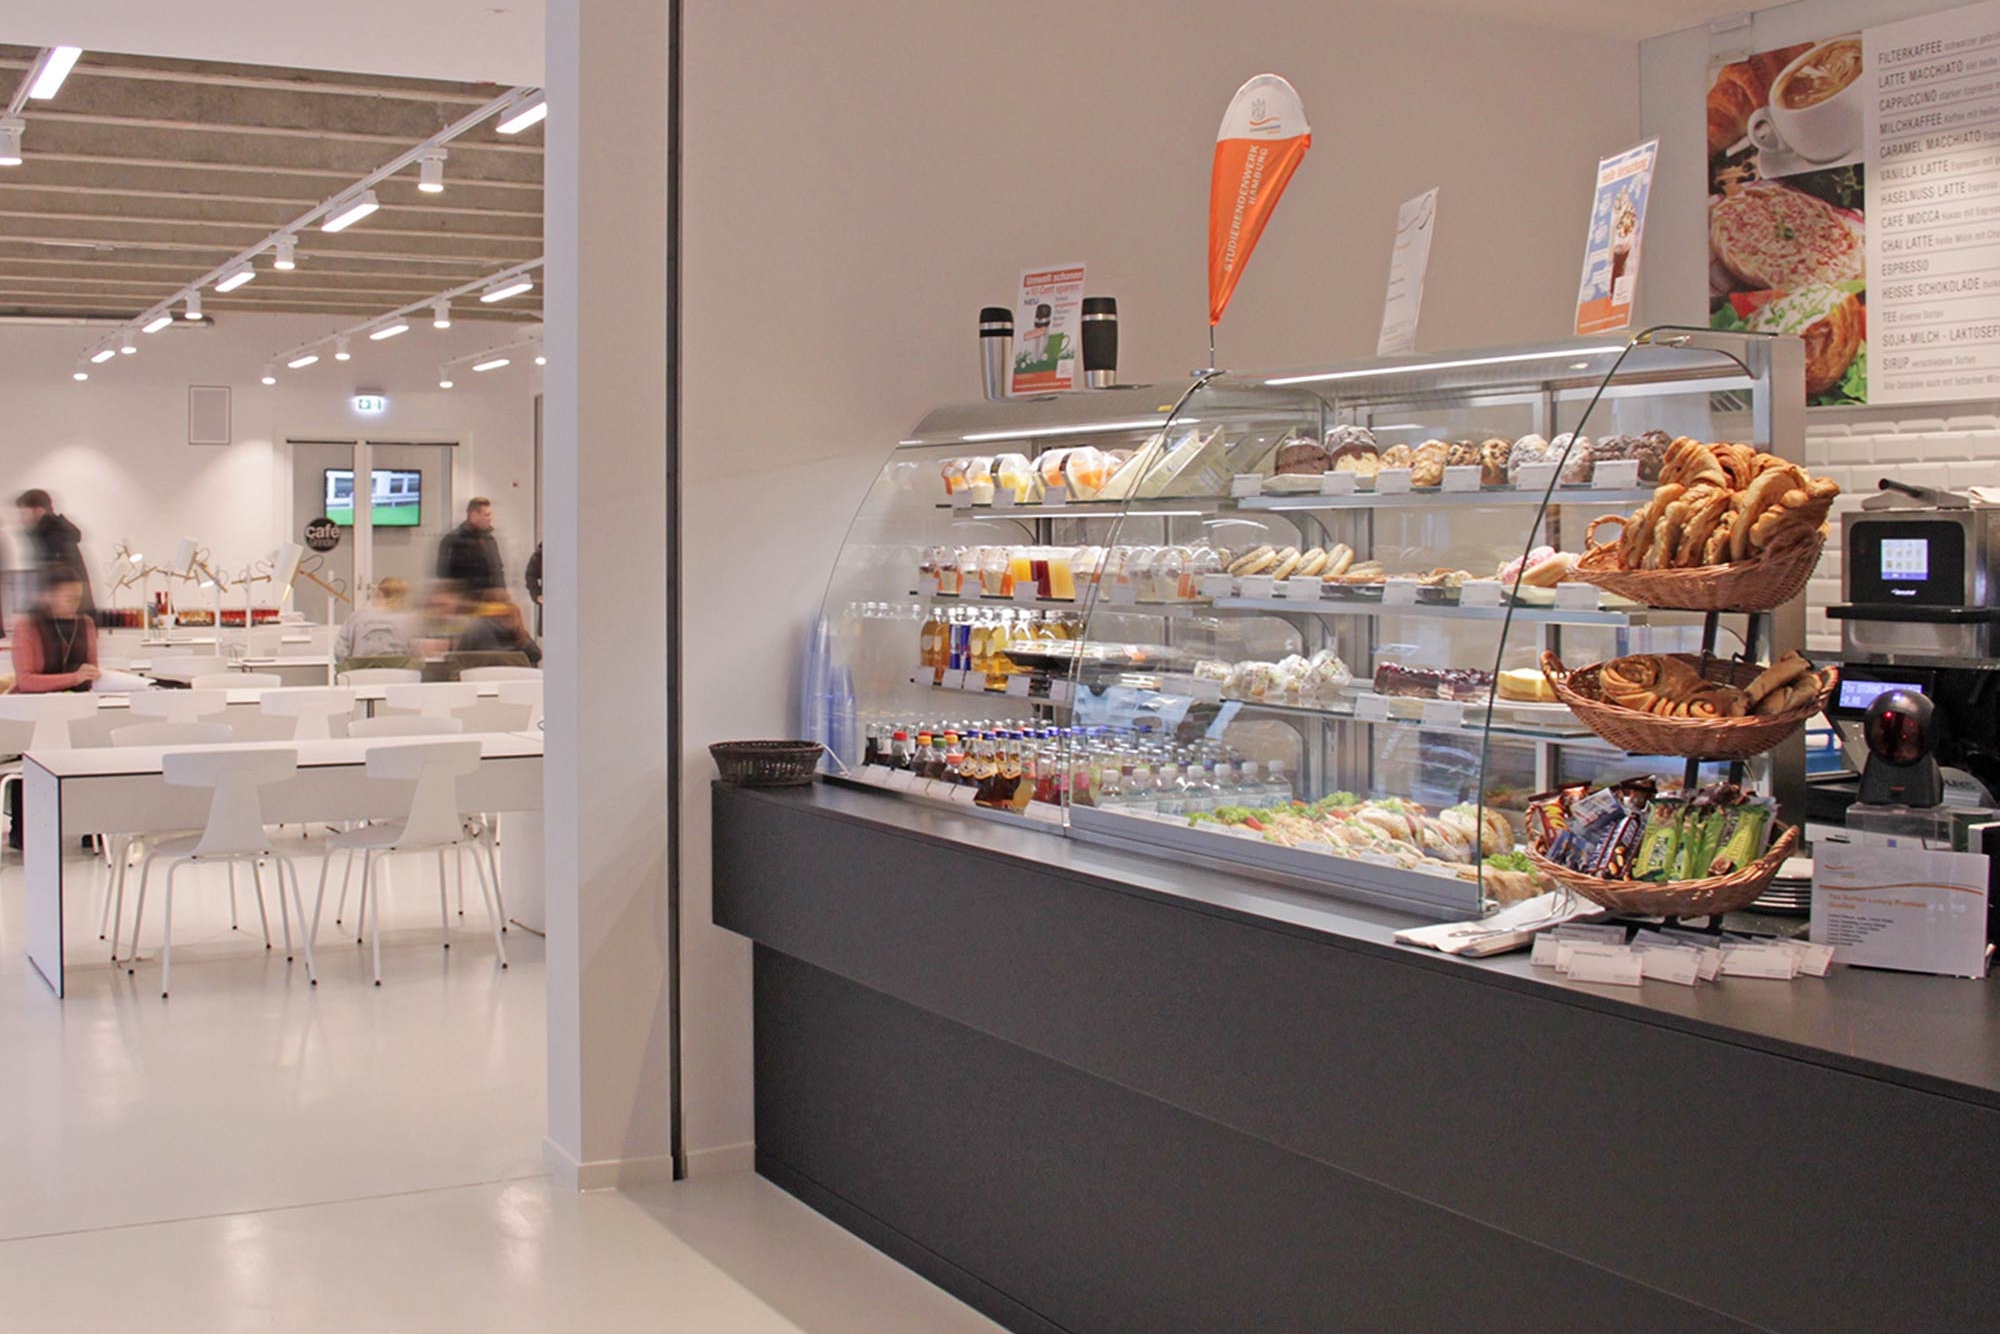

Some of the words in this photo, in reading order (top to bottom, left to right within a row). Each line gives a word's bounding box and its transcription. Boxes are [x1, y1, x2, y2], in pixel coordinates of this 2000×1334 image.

[1878, 40, 1942, 64] FILTERKAFFEE
[1878, 71, 1906, 88] LATTE
[1909, 60, 1964, 81] MACCHIATO
[1879, 89, 1937, 111] CAPPUCCINO
[1879, 112, 1942, 134] MILCHKAFFEE
[1879, 140, 1922, 159] CARAMEL
[1926, 129, 1981, 150] MACCHIATO
[1248, 147, 1269, 205] HAMBURG
[1880, 165, 1918, 182] VANILLA
[1920, 160, 1949, 176] LATTE
[1880, 186, 1935, 205] HASELNUSS
[1937, 181, 1966, 196] LATTE
[1224, 145, 1260, 272] STUDIERENDENWERK
[1907, 210, 1940, 225] MOCCA
[1881, 238, 1903, 252] CHAI
[1905, 234, 1934, 250] LATTE
[1882, 259, 1929, 276] ESPRESSO
[1882, 284, 1914, 300] HEISSE
[1917, 277, 1980, 296] SCHOKOLADE
[1882, 311, 1897, 323] TEE
[1882, 330, 1940, 347] SOJA-MILCH
[1882, 356, 1910, 371] SIRUP
[306, 523, 341, 539] café
